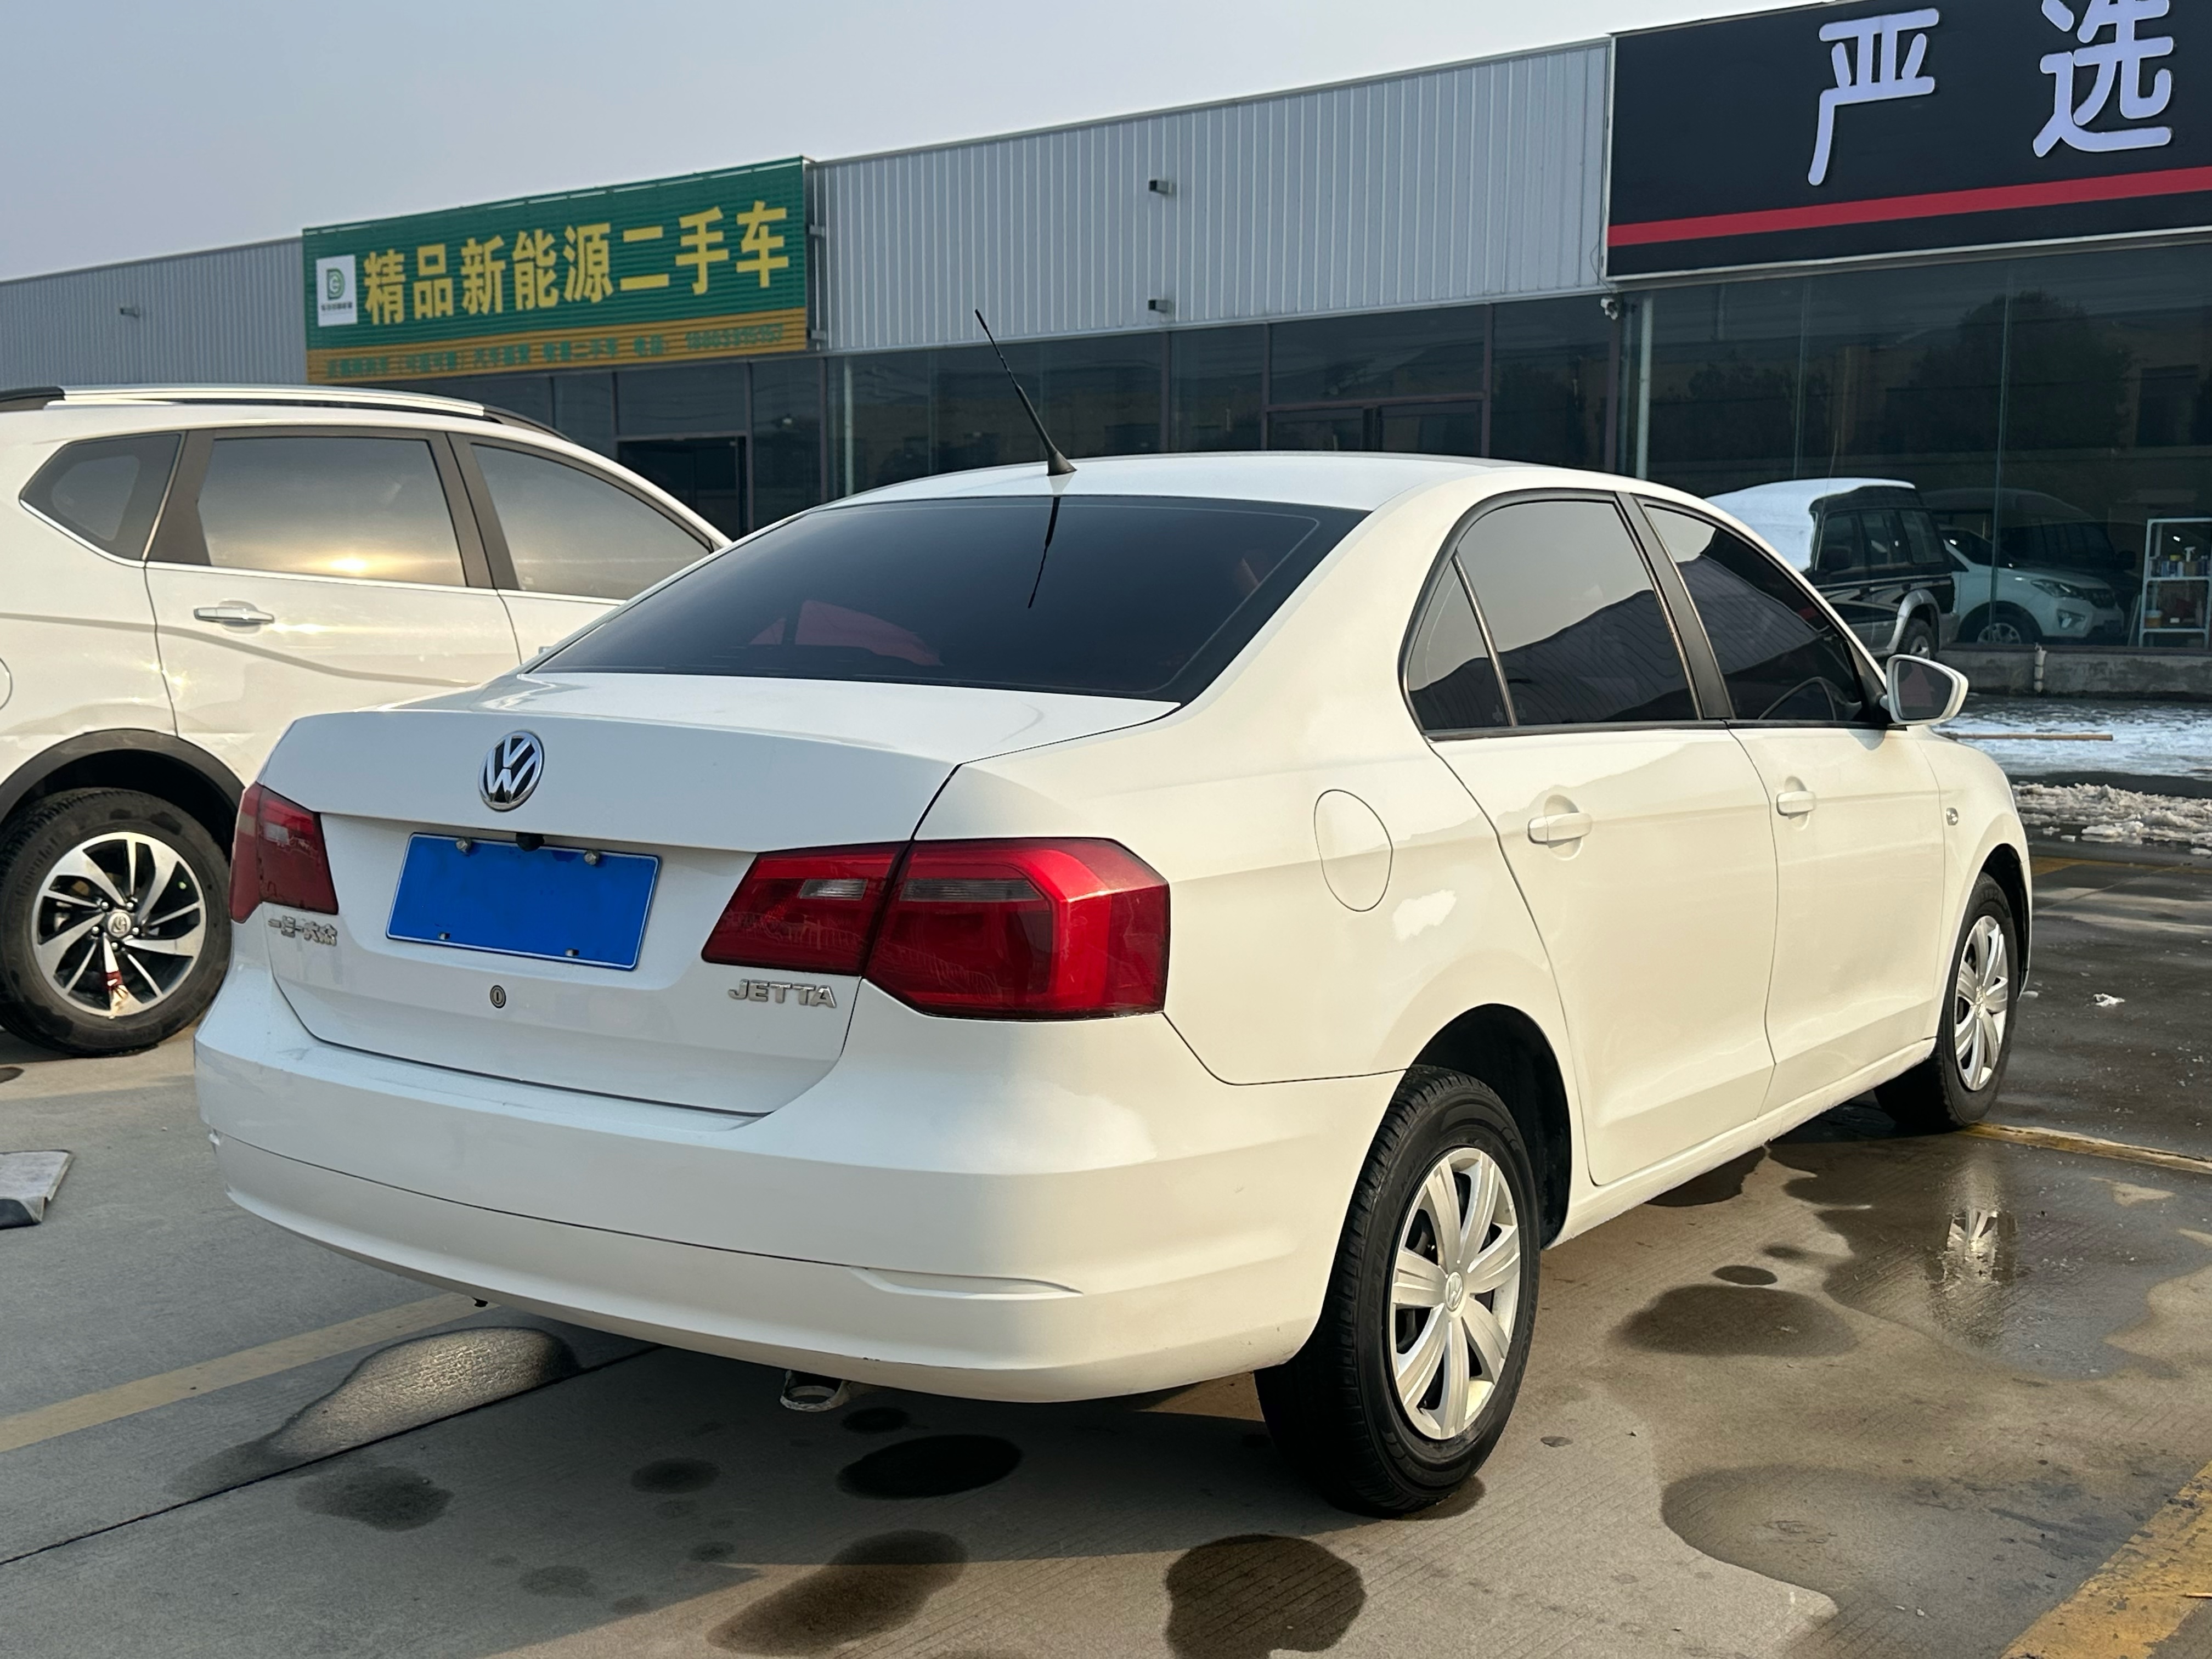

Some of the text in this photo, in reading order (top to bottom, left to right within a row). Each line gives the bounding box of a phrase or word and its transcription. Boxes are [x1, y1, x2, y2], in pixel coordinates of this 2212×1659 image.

[1808, 0, 2174, 186] 严选
[364, 200, 789, 325] 精品新能源二手车
[727, 978, 837, 1008] JETTA
